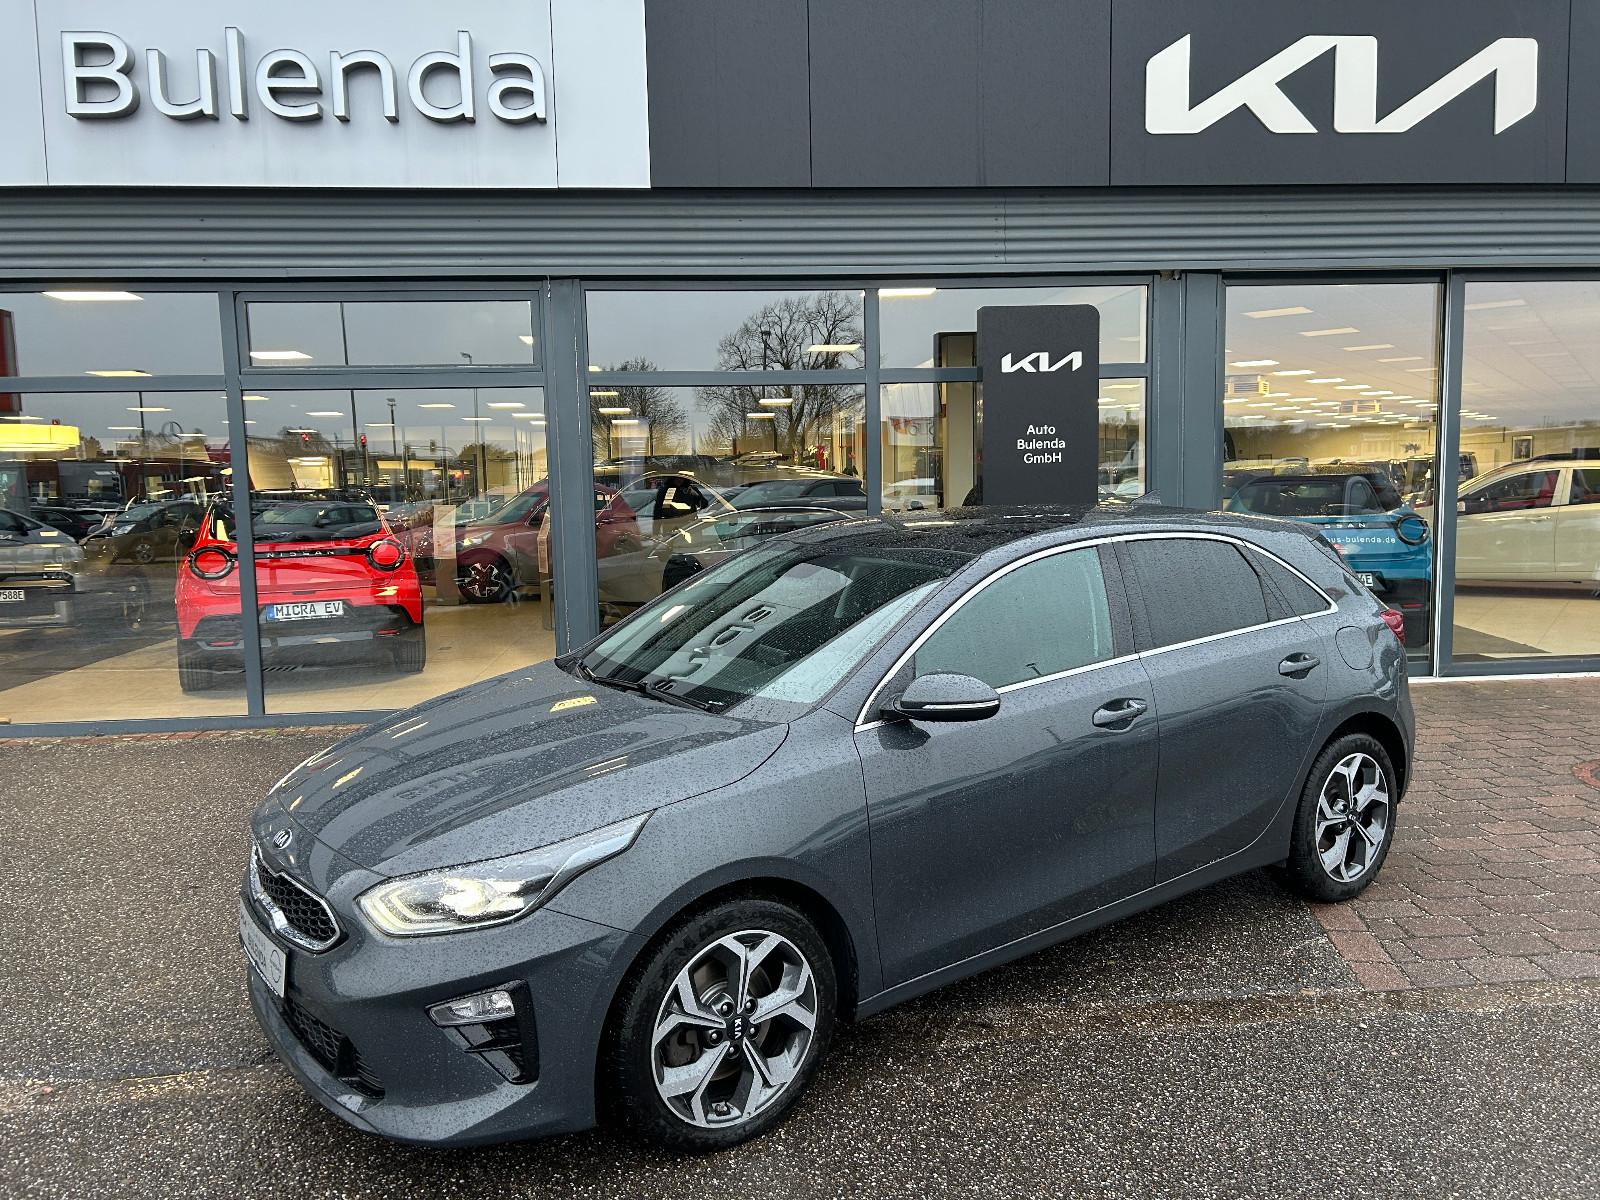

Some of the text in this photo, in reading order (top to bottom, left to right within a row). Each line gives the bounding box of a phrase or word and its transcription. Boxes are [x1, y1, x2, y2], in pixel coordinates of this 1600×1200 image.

[60, 26, 548, 124] Bulenda
[1145, 34, 1539, 135] KIA
[1001, 351, 1082, 373] KIA
[1026, 424, 1056, 435] Auto
[1017, 438, 1066, 450] Bulenda
[1023, 452, 1062, 463] GmbH
[0, 590, 23, 600] 588E
[275, 602, 341, 617] MICRA EV
[734, 1017, 742, 1040] KIA
